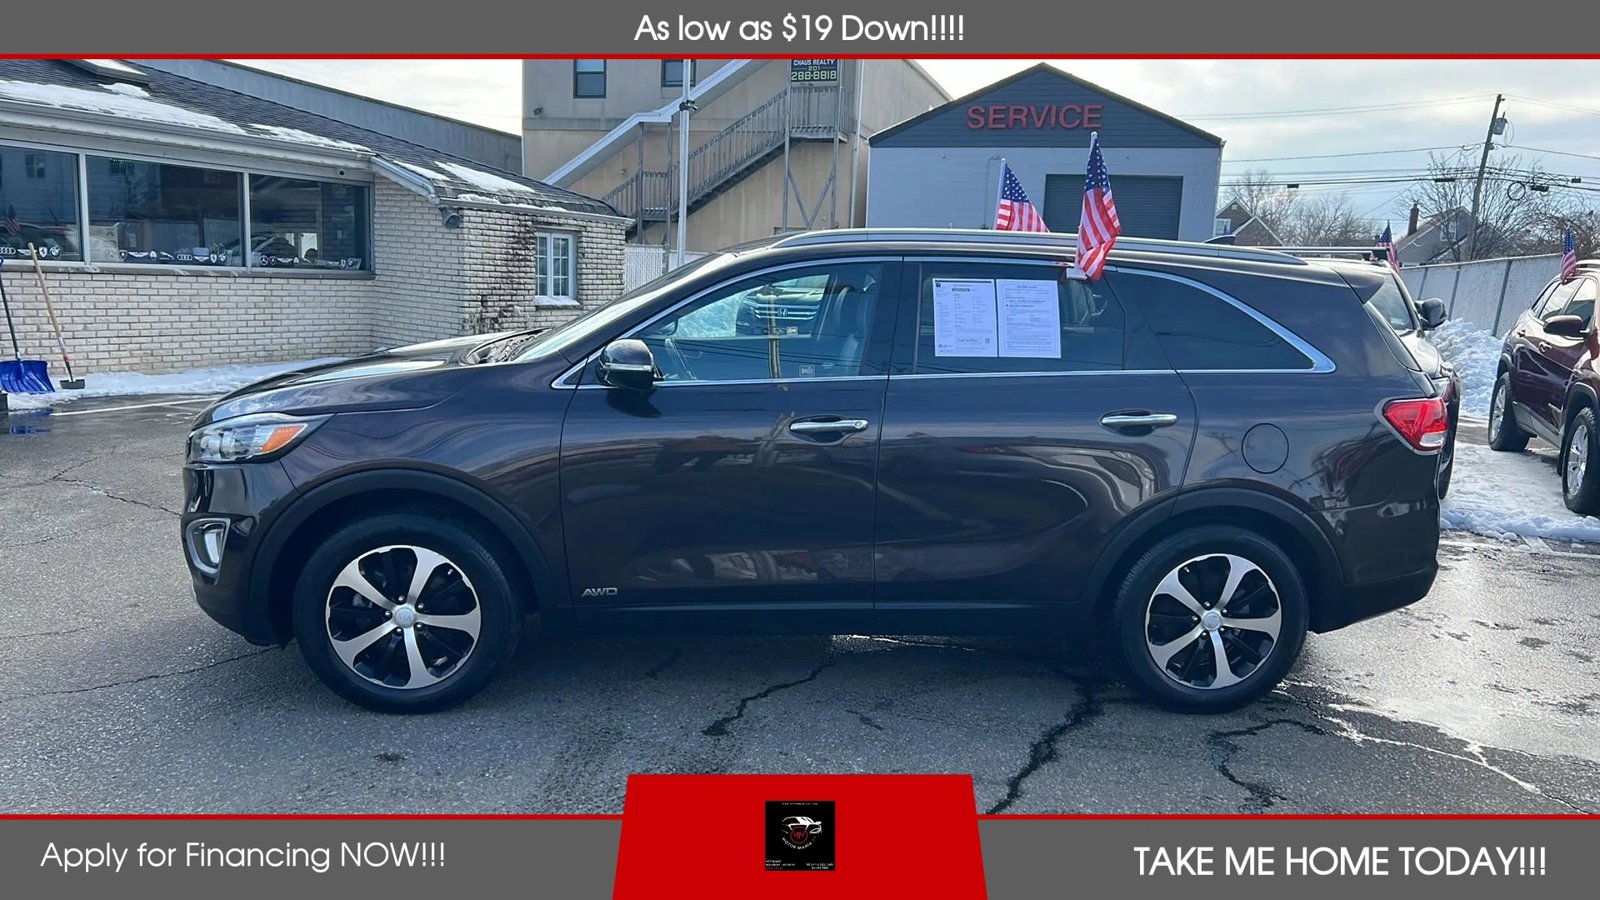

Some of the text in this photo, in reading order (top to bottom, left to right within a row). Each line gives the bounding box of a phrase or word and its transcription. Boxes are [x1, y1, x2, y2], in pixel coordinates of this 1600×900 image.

[791, 71, 837, 80] 288-8818
[966, 104, 1103, 129] SERVICE
[581, 587, 618, 597] AWD
